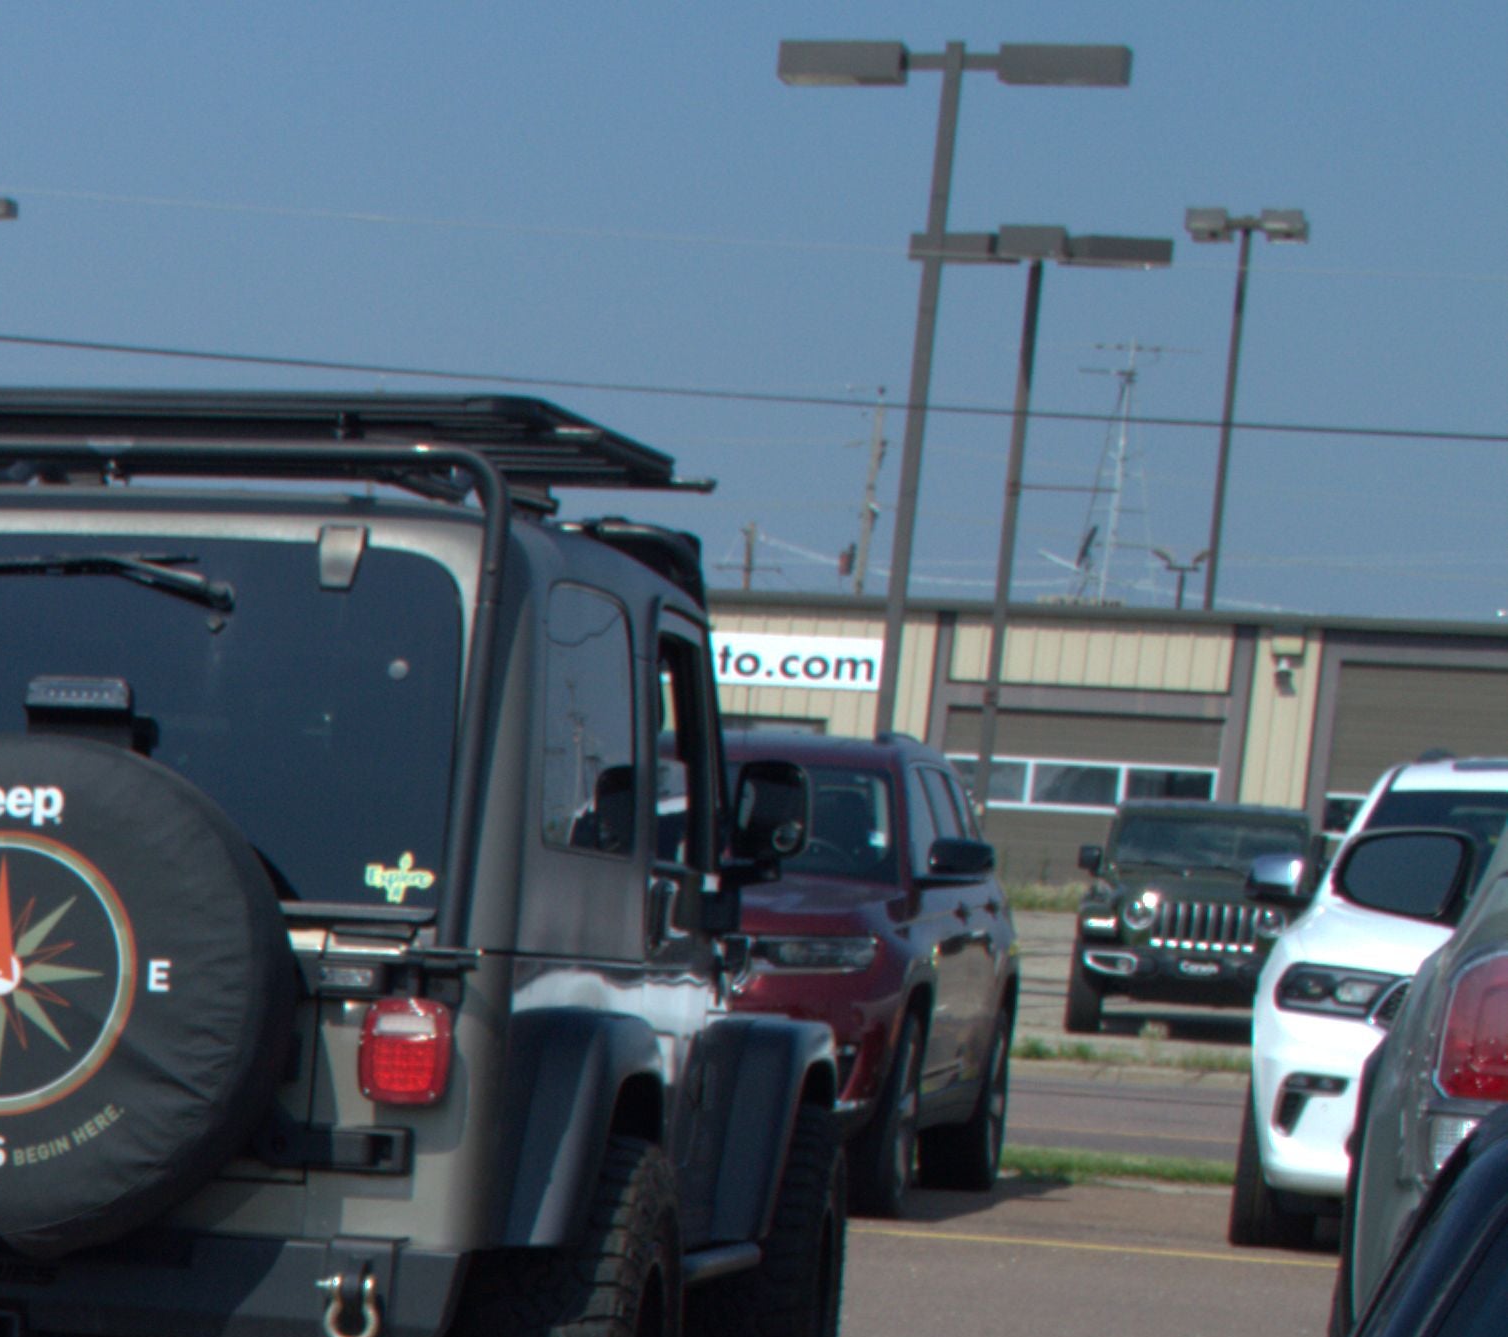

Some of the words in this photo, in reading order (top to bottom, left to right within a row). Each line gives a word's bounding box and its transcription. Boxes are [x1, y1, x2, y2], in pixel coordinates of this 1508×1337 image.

[718, 645, 874, 682] to.com
[146, 959, 172, 992] E
[12, 1135, 72, 1167] BEGIN
[71, 1103, 125, 1147] HERE.
